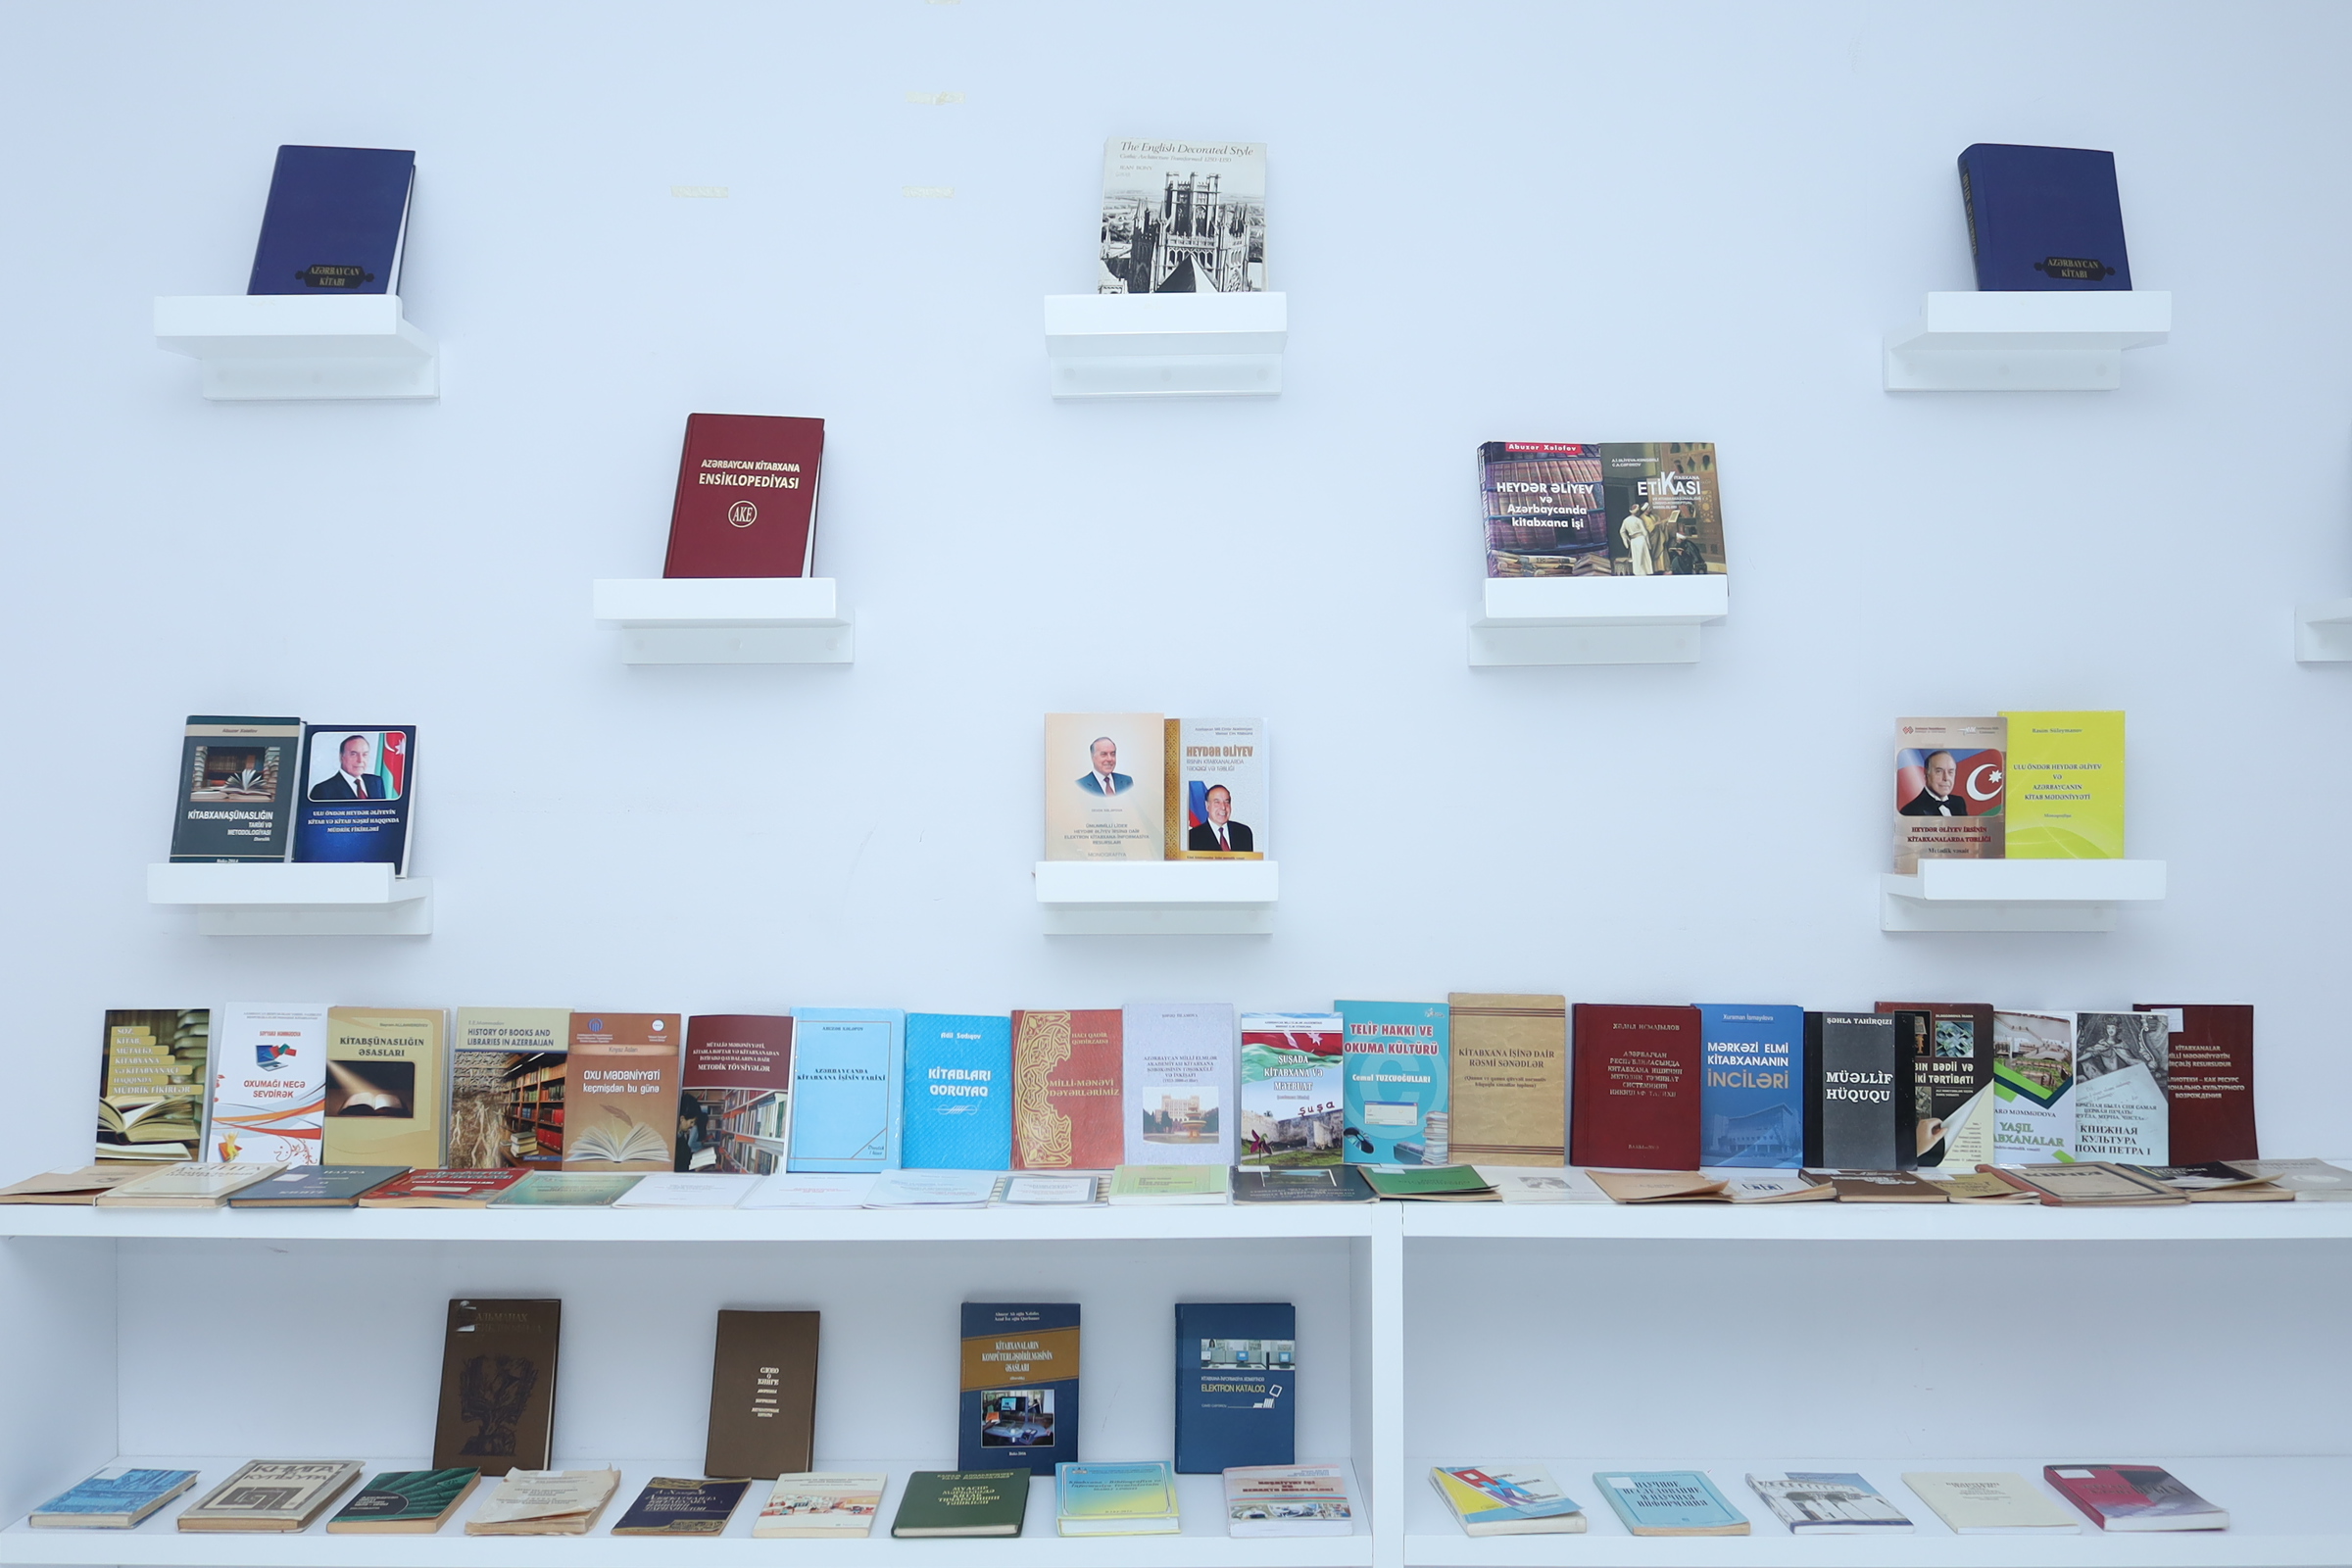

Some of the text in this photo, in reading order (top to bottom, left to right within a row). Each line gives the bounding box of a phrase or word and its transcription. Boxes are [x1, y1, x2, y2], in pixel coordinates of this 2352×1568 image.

[1121, 141, 1253, 157] The English Decorated Style
[2047, 260, 2099, 269] AZƏRBAYCAN
[309, 266, 360, 275] AZƏRBAYCAN
[319, 277, 345, 286] KİTABI
[701, 460, 800, 472] AZƏRBAYCAN KİTABXANA
[699, 472, 800, 489] ENSİKLOPEDİYASI
[1496, 481, 1593, 494] HEYDƏR ƏLİYEV
[733, 507, 753, 522] AKE
[1507, 505, 1587, 515] Azərbaycanda
[1512, 517, 1584, 530] kitabxana işi
[1187, 745, 1253, 757] HEYDƏR ƏLİYEV
[188, 809, 273, 821] KİTABXANAŞÜNASLIĞIN
[1854, 1017, 1892, 1026] TAHİRQIZI
[468, 1028, 497, 1037] HISTORY
[1350, 1021, 1433, 1036] TELİF HAKKI VE
[339, 1037, 424, 1047] KİTABŞÜNASLIĞIN
[512, 1038, 555, 1047] AZERBAIJAN
[1345, 1042, 1439, 1054] OKUMA KÜLTÜRÜ
[1707, 1042, 1788, 1054] MƏRKƏZİ ELMİ
[1509, 1049, 1532, 1058] İŞİNƏ
[1534, 1049, 1554, 1057] DAİR
[1278, 1055, 1309, 1065] ŞUŞADA
[1469, 1058, 1544, 1068] RƏSMİ SƏNƏDLƏR
[1707, 1054, 1788, 1067] KİTABXANANIN
[728, 1063, 770, 1072] TÖVSİYƏLƏR
[1933, 1061, 1957, 1071] BƏDİİ
[584, 1068, 661, 1081] OXU MƏDƏNİYYƏTİ
[929, 1066, 992, 1081] KİTABLARI
[1264, 1068, 1310, 1077] KİTABXANA
[1826, 1070, 1893, 1085] MÜƏLLİF
[1376, 1073, 1431, 1083] TUZCUOĞULLARI
[1707, 1068, 1788, 1089] İNCİLƏRİ
[1929, 1073, 1974, 1084] TƏRTİBATI
[583, 1083, 660, 1095] keçmişdən bu günə
[930, 1085, 989, 1097] QORUYAQ
[1274, 1082, 1312, 1091] MƏTBUAT
[1050, 1088, 1119, 1097] DƏYƏRLƏRİMİZ
[1826, 1089, 1890, 1103] HÜQUQU
[2009, 1109, 2056, 1118] MƏMMƏDOVA
[1999, 1122, 2034, 1132] YAŞIL
[2081, 1125, 2138, 1135] КНИЖНАЯ
[2082, 1136, 2136, 1145] КУЛЬТУРА
[2109, 1145, 2144, 1155] ПЕТРА
[1201, 1384, 1265, 1393] ELEKTRON KATALOQ
